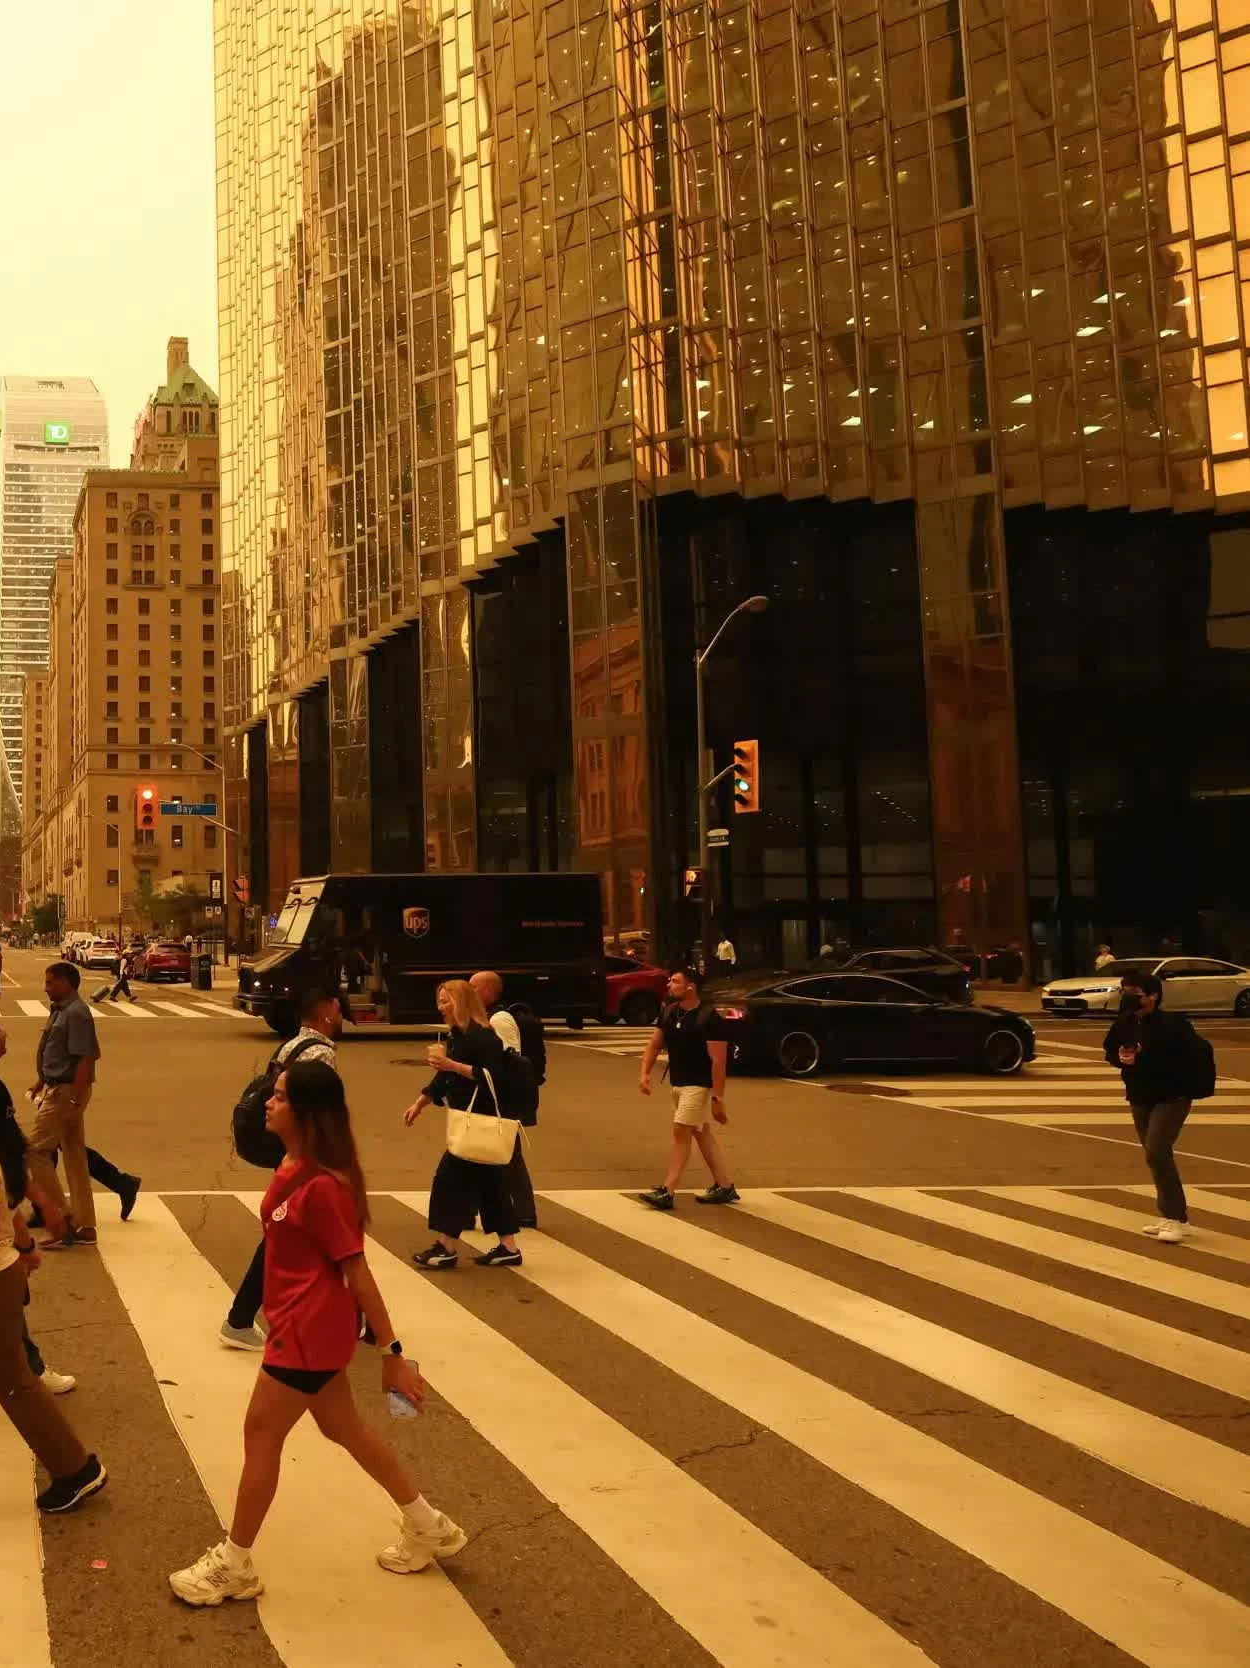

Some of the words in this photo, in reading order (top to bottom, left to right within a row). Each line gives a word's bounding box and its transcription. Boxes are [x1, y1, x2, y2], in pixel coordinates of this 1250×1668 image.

[48, 424, 68, 439] TD
[176, 804, 193, 814] Bay
[405, 916, 429, 934] ups
